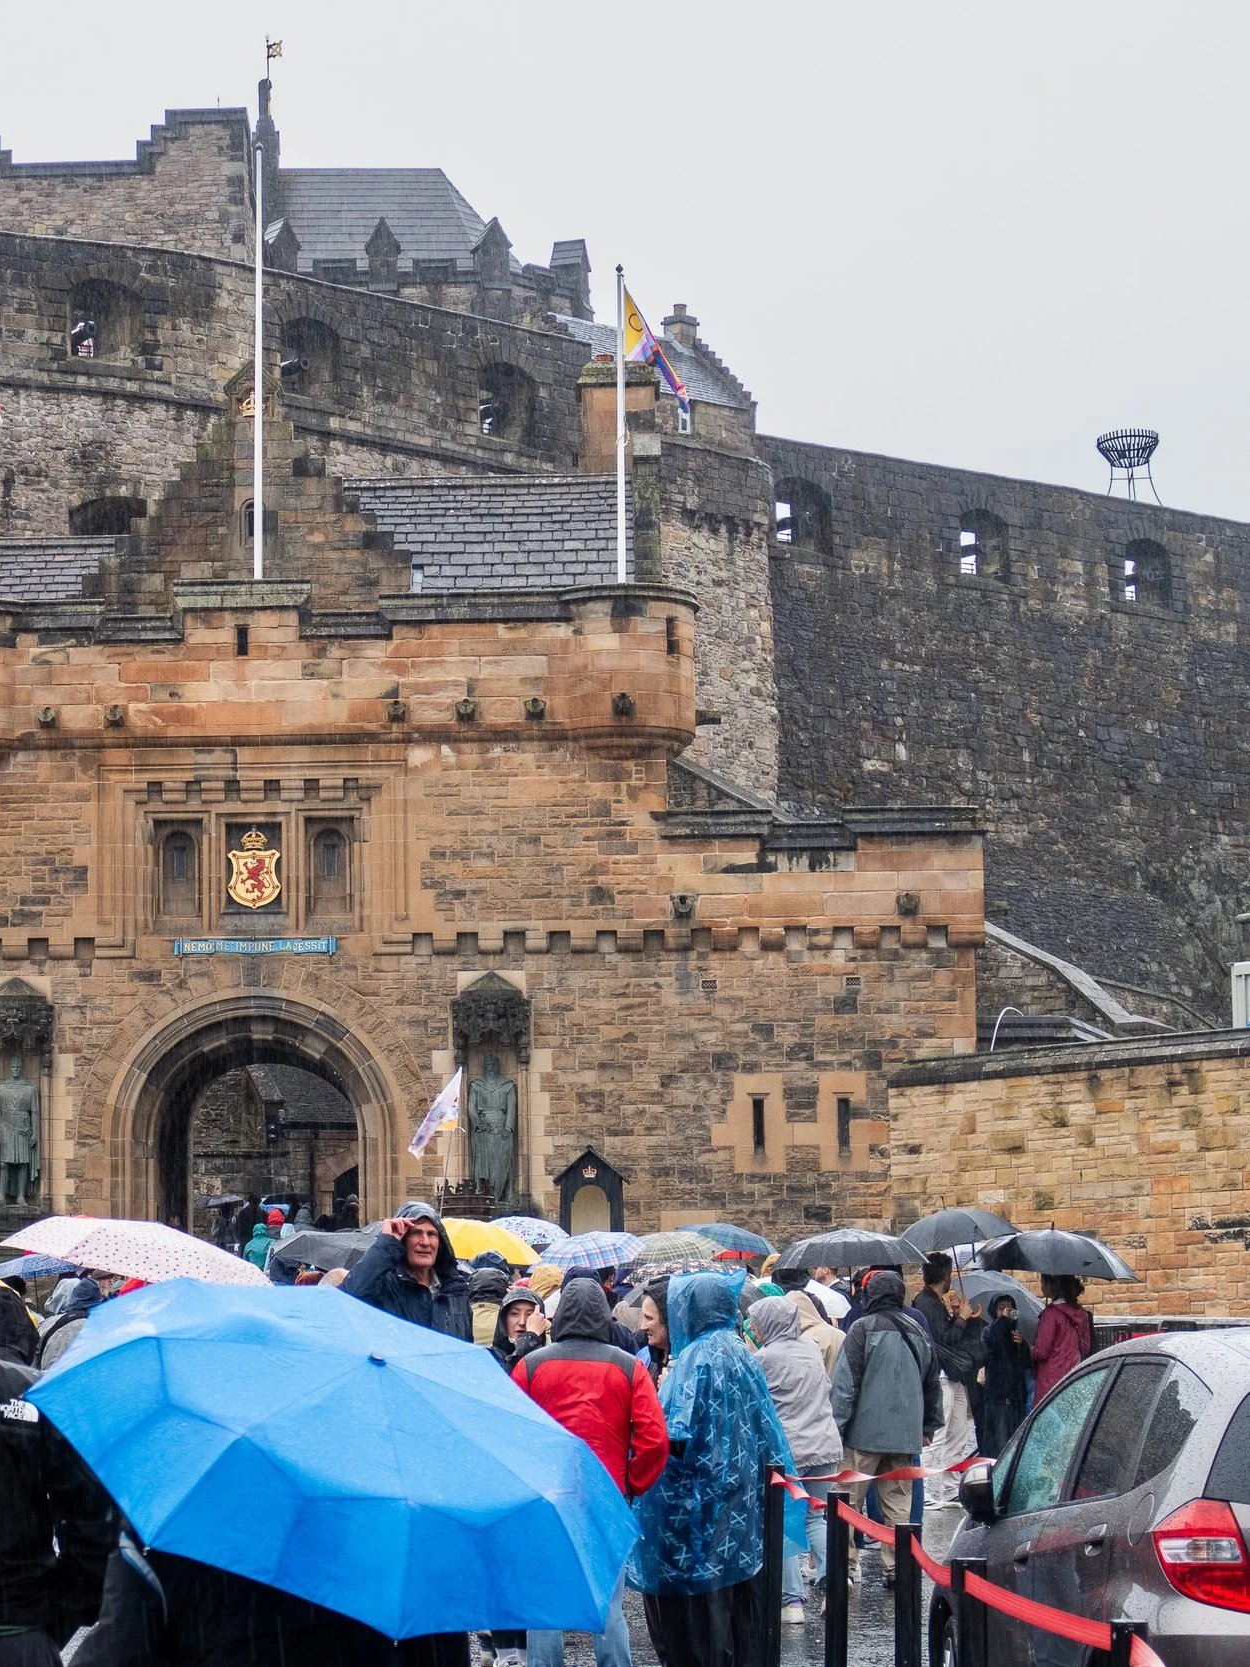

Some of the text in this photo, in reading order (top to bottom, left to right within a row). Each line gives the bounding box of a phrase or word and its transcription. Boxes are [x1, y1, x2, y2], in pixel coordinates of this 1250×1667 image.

[184, 942, 212, 952] NEMO
[216, 941, 230, 952] ME
[236, 942, 274, 953] IMPUNE
[10, 1398, 25, 1409] THE
[4, 1411, 24, 1420] FACE
